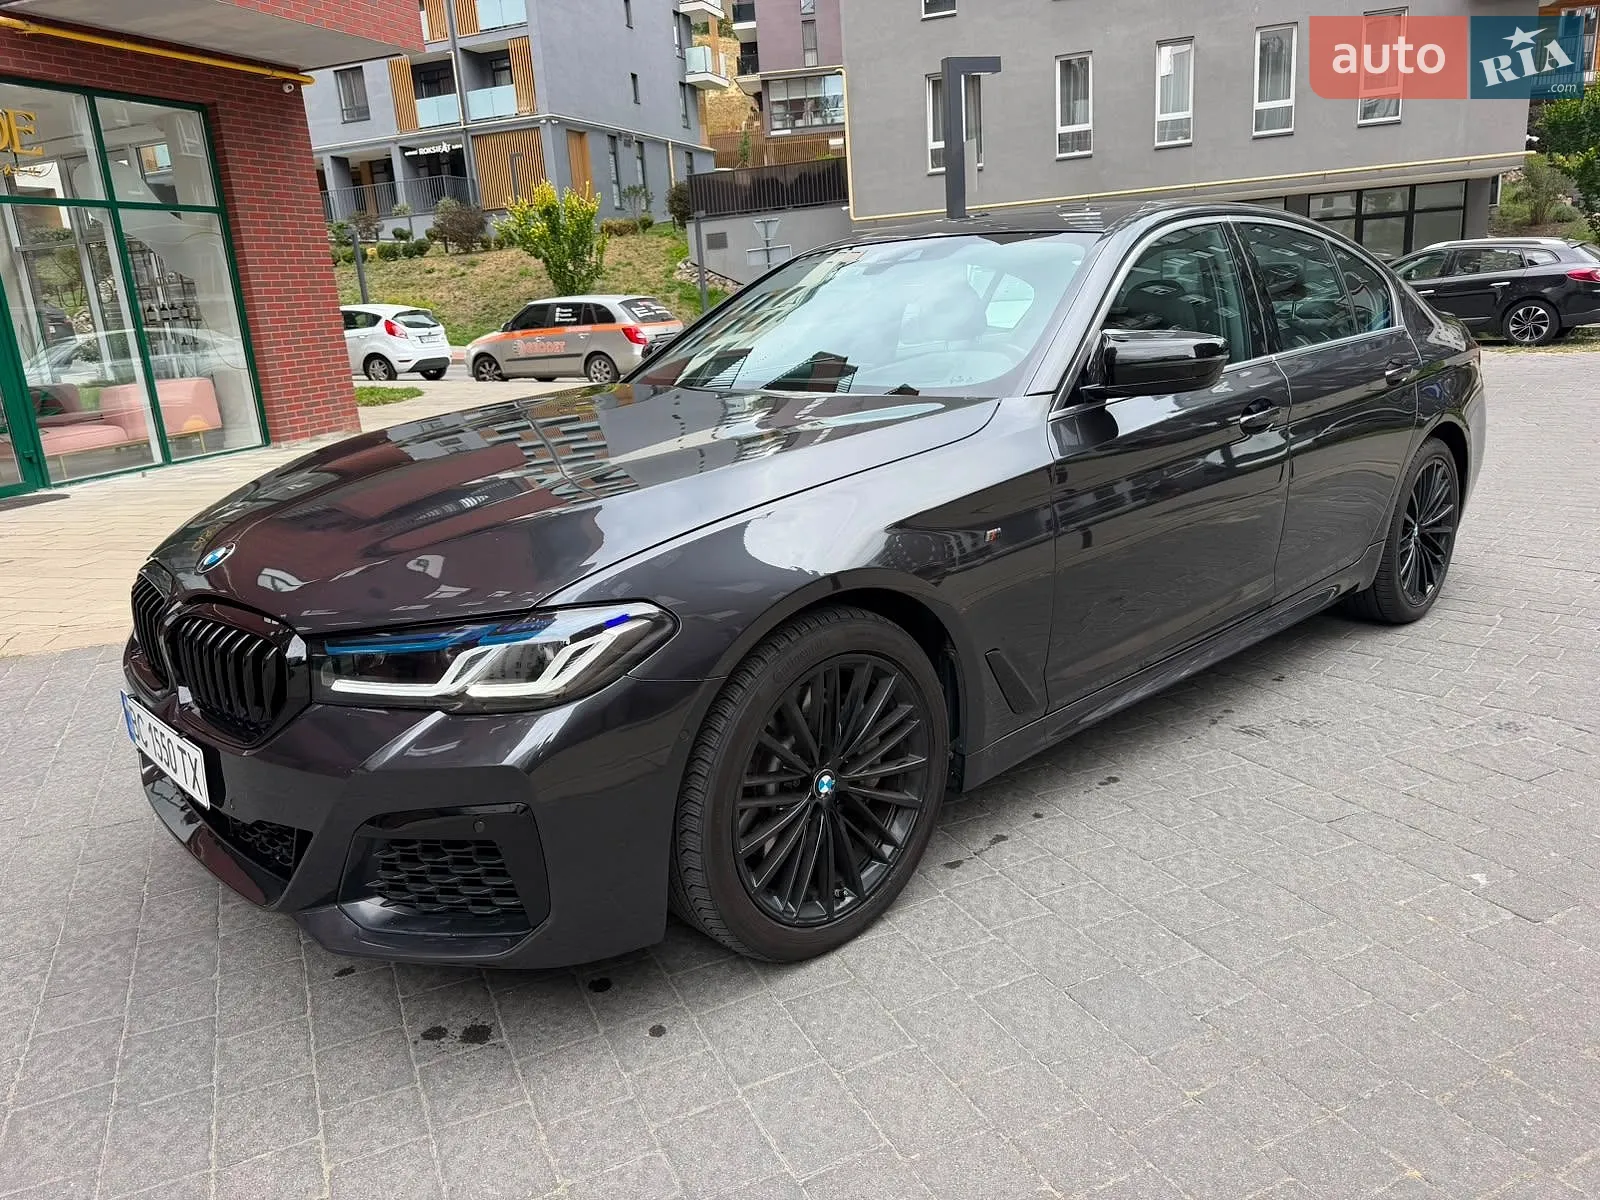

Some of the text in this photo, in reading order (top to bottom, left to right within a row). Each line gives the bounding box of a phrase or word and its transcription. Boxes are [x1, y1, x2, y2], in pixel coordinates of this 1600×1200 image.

[129, 705, 203, 797] BC 1550 TX
